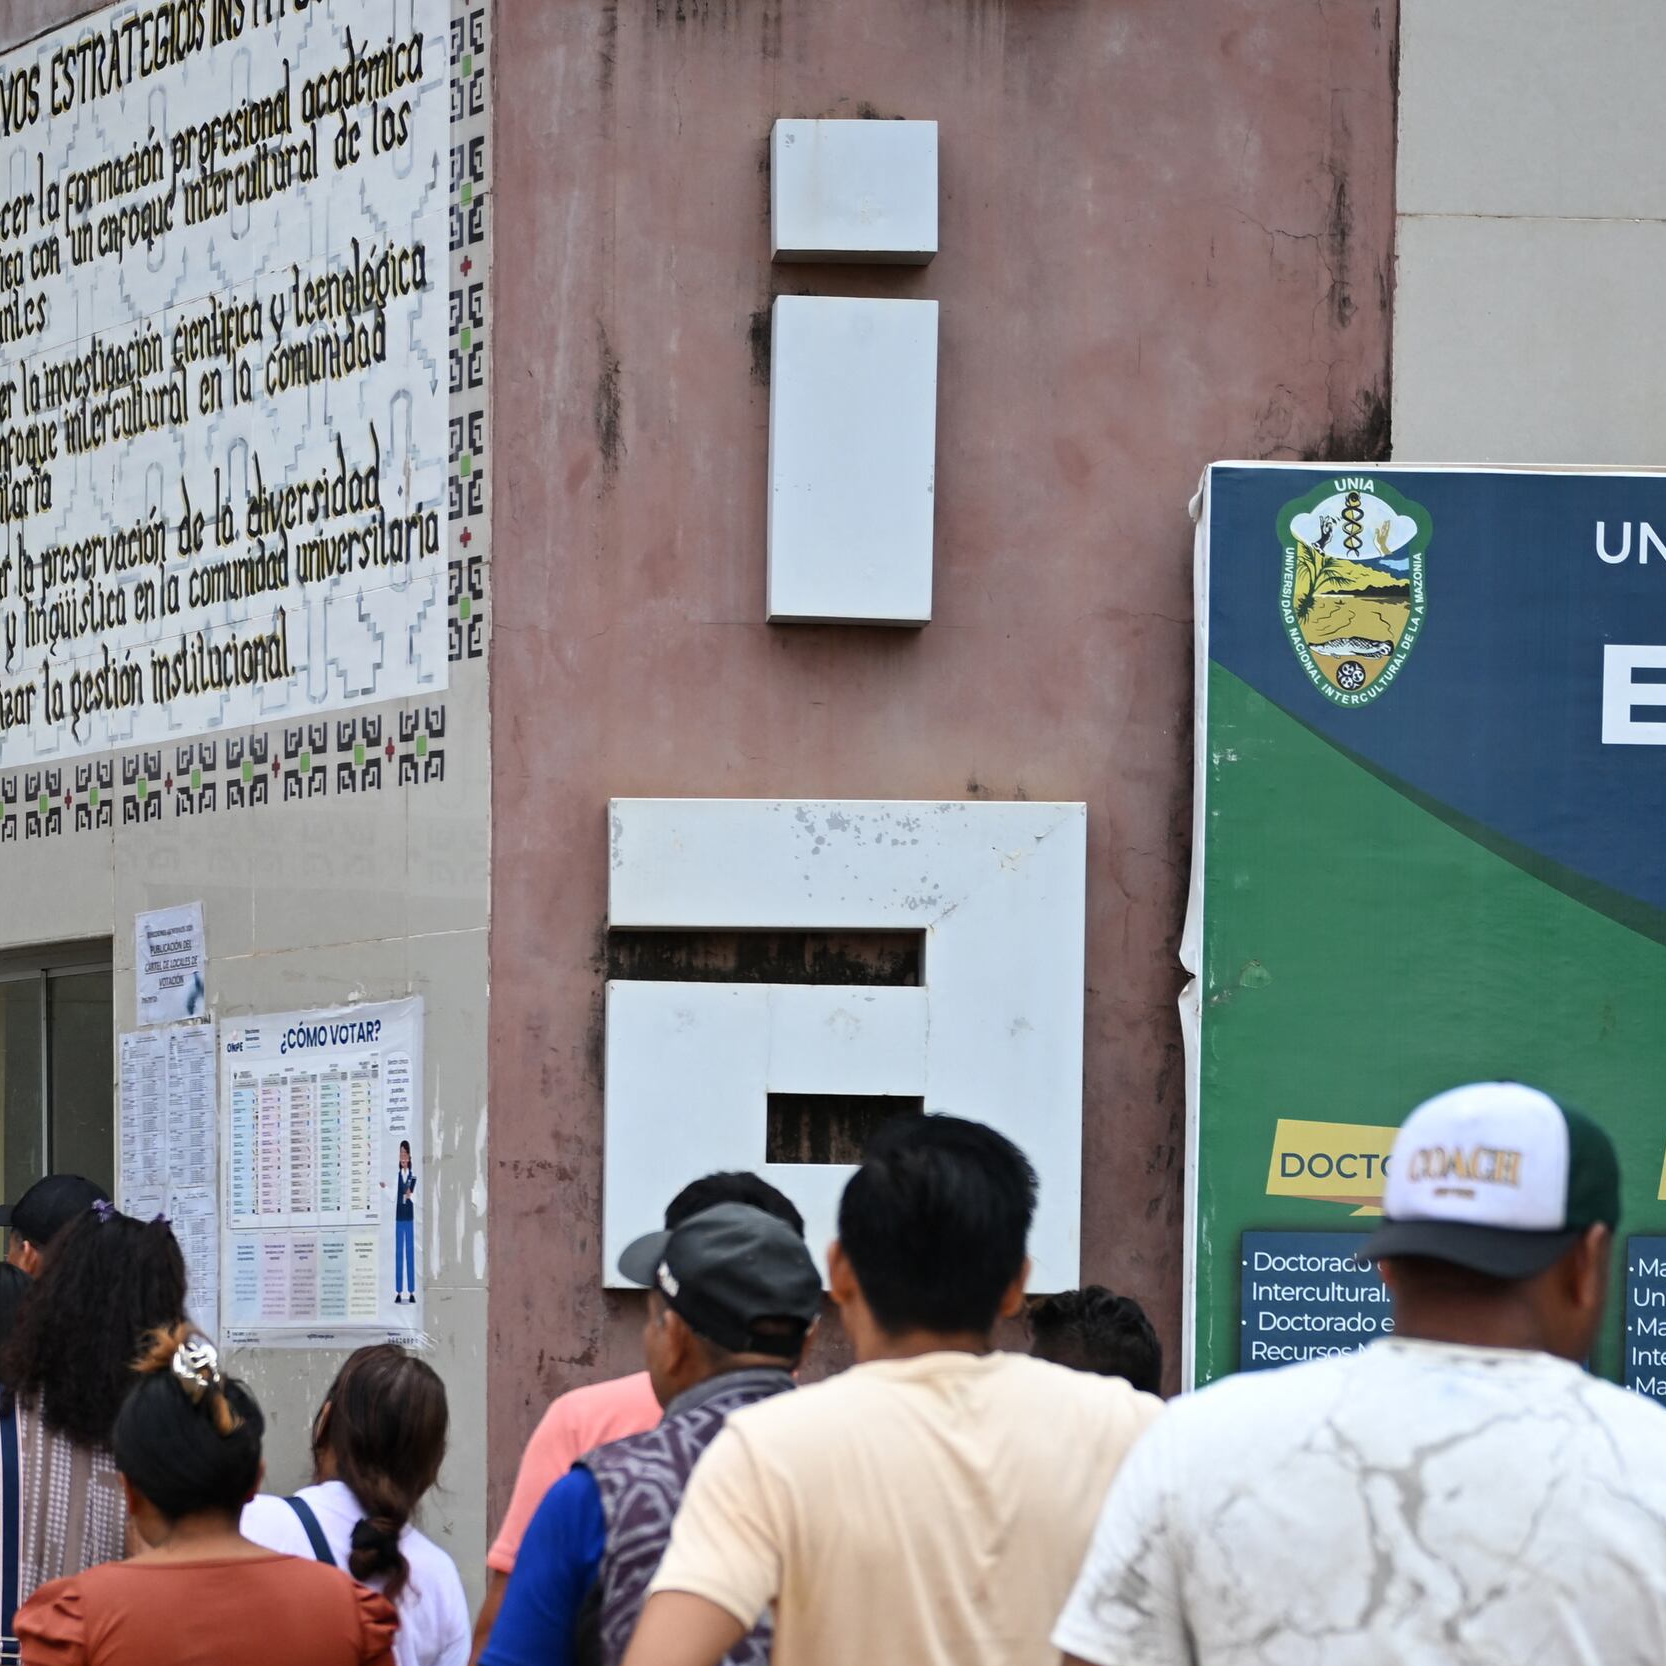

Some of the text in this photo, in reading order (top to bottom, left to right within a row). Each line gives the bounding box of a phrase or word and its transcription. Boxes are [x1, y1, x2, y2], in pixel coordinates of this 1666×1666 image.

[49, 0, 206, 118] ESTRATEGICOS
[30, 235, 61, 281] con
[70, 219, 94, 267] un
[97, 192, 174, 265] enfoque
[183, 123, 319, 227] intercultural
[333, 106, 361, 171] de
[371, 99, 413, 156] los
[37, 152, 61, 229] la
[65, 125, 164, 238] formación
[172, 58, 293, 200] profesional
[301, 25, 424, 124] académica
[19, 359, 41, 417] la
[42, 321, 164, 408] investigación
[269, 293, 284, 350] y
[290, 237, 427, 328] tecnológica
[64, 364, 189, 456] intercultural
[199, 366, 223, 416] en
[232, 350, 253, 407] la
[265, 310, 386, 400] comunidad
[17, 531, 35, 597] la
[40, 505, 167, 604] preservación
[177, 474, 206, 557] de
[213, 466, 235, 547] la
[246, 417, 380, 541] diversidad
[1334, 477, 1375, 493] UNIA
[5, 611, 17, 674] y
[133, 576, 156, 624] en
[158, 562, 181, 617] la
[188, 530, 289, 609] comunidad
[1289, 627, 1321, 685] NACIONAL
[1321, 652, 1408, 706] INTERCULTURAL
[1402, 632, 1415, 650] DE
[1409, 616, 1421, 633] LA
[40, 657, 65, 725] la
[70, 642, 144, 746] gestión
[149, 605, 296, 704] institucional.
[280, 1021, 327, 1054] ¿CÓMO
[330, 1019, 381, 1045] VOTAR?
[1408, 1144, 1523, 1188] COACH
[1252, 1281, 1390, 1302] Intercultural.
[1254, 1252, 1371, 1272] Doctorado
[1259, 1312, 1395, 1332] Doctorado e
